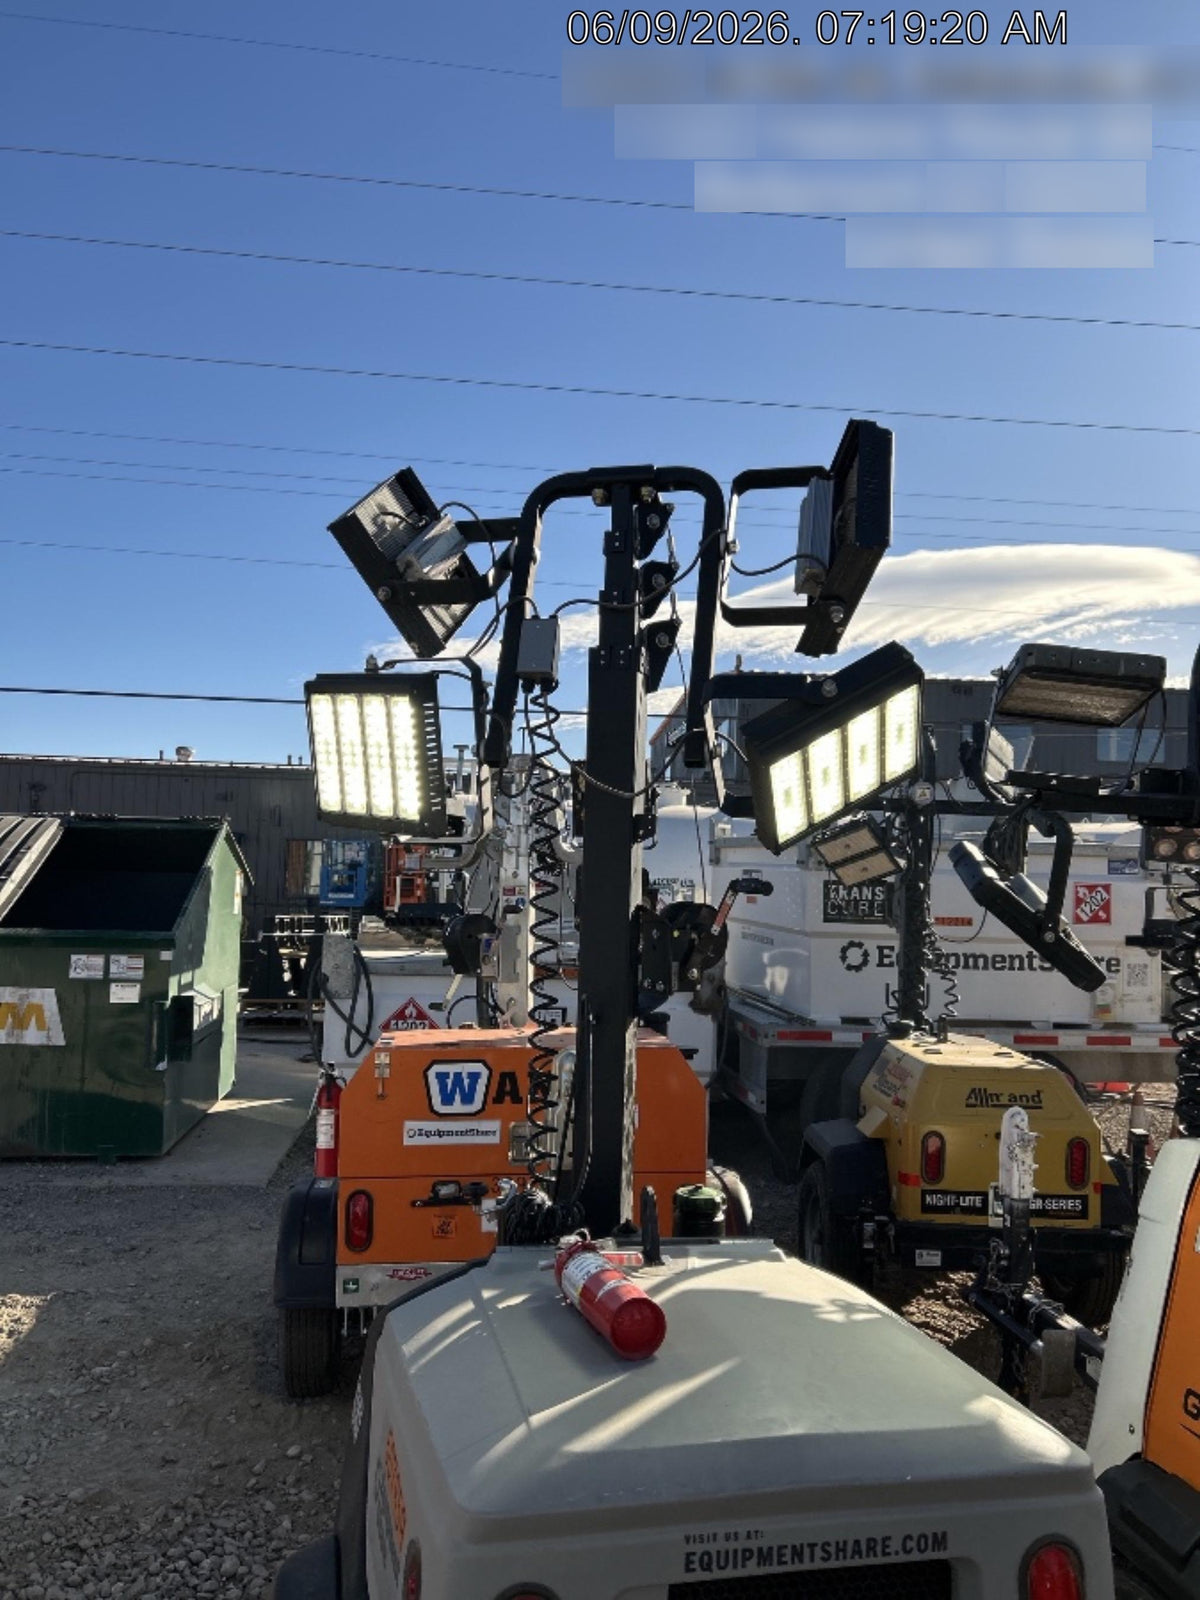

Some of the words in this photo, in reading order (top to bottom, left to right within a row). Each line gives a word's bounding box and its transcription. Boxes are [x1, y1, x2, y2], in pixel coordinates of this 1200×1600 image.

[1079, 889, 1107, 918] 1202
[683, 1530, 948, 1574] EQUIPMENTSHARE.COM
[684, 1532, 718, 1545] VISIT
[724, 1531, 739, 1542] US
